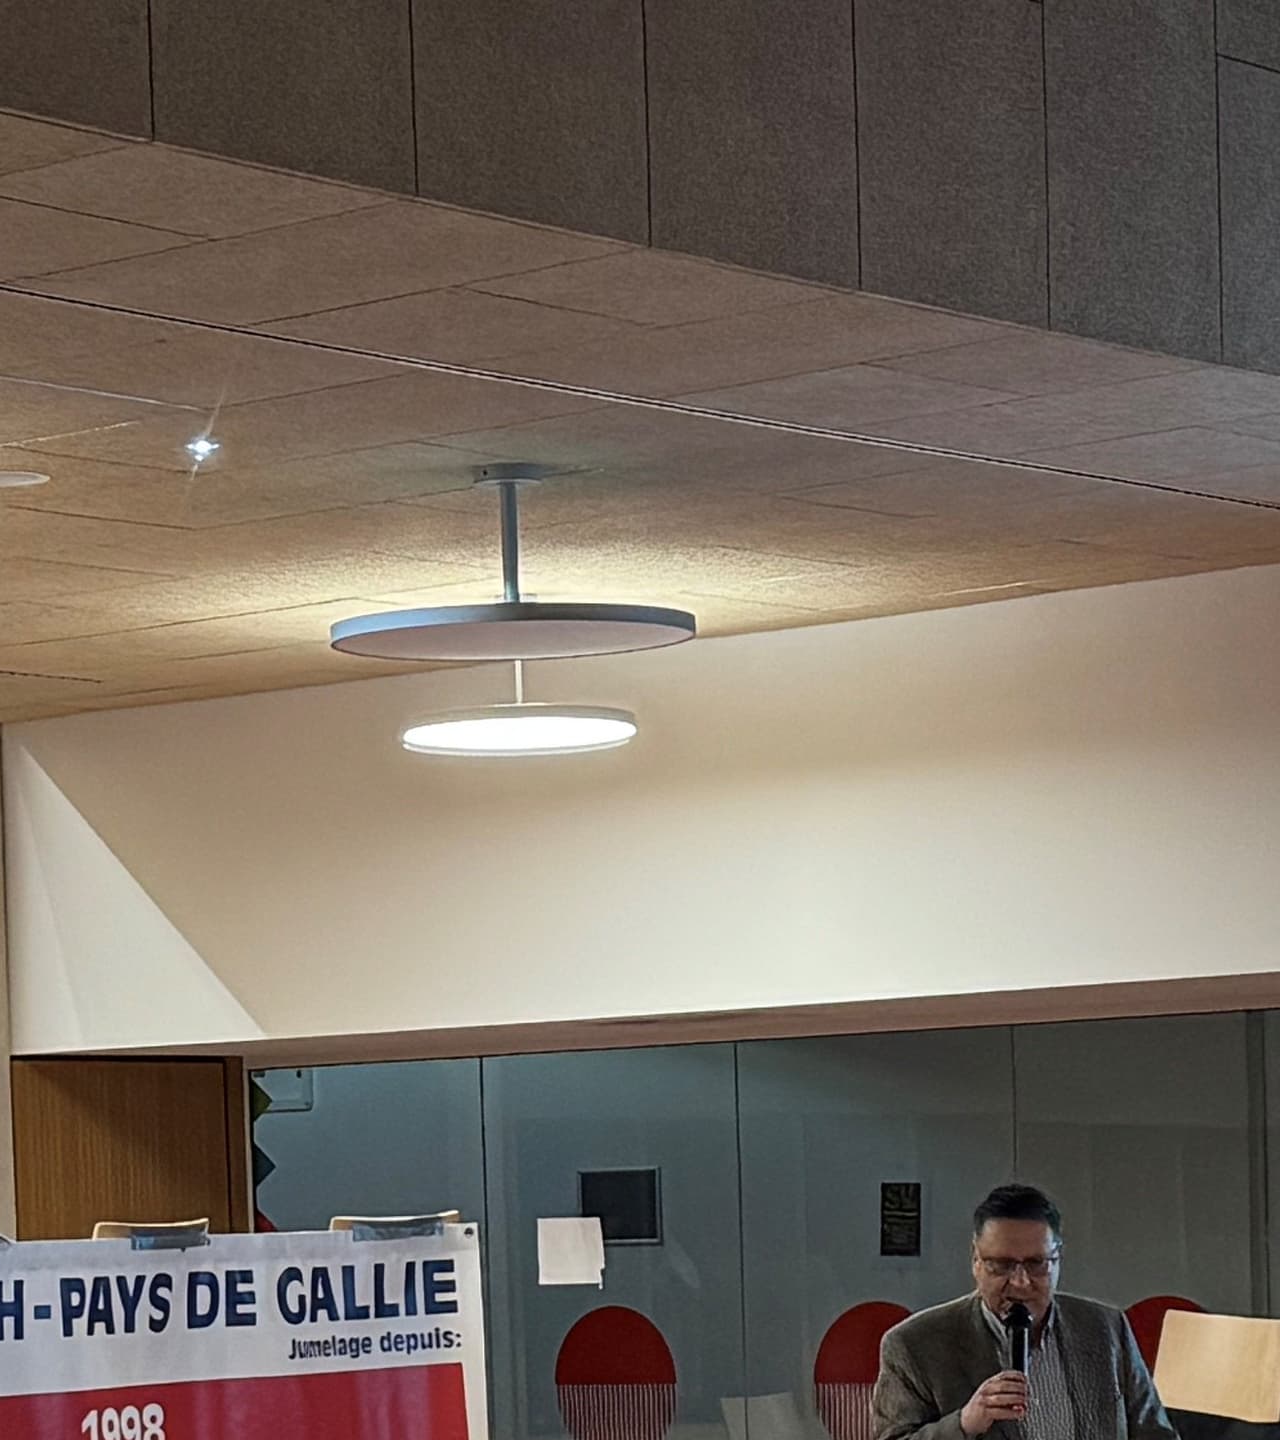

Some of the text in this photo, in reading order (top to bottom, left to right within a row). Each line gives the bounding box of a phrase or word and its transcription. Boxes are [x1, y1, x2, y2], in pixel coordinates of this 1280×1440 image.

[186, 1269, 257, 1330] DE
[277, 1258, 459, 1326] GALLIE
[288, 1327, 463, 1360] Jumelage depuis:
